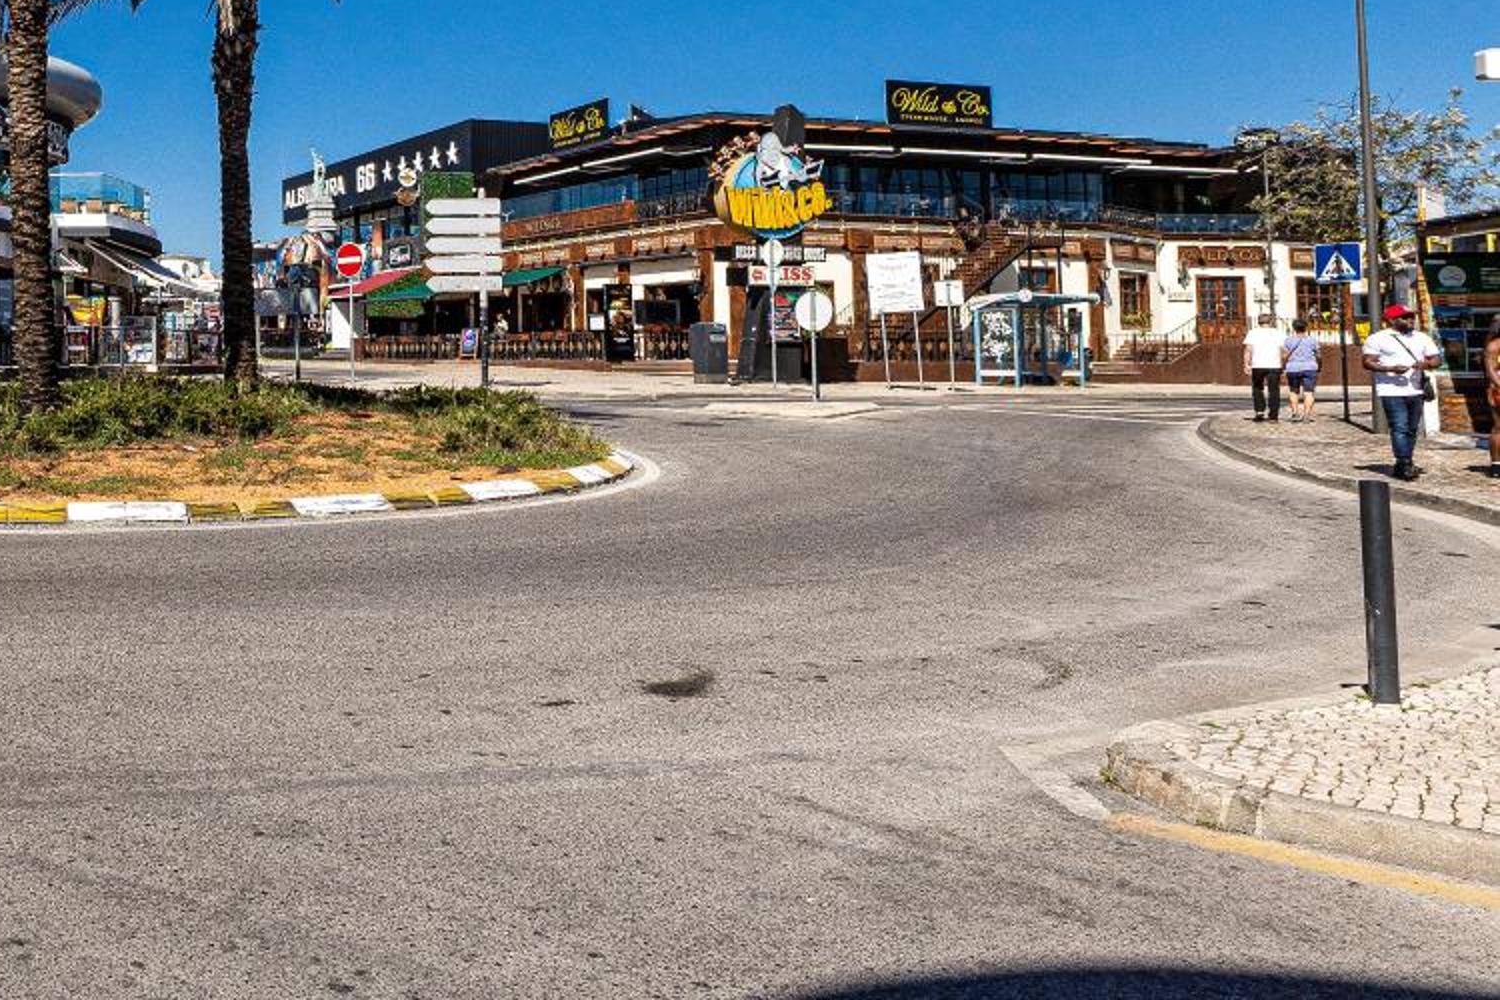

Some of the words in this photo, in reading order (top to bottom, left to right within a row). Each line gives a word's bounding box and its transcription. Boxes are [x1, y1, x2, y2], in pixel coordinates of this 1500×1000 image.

[892, 86, 939, 113] Wild
[356, 162, 376, 194] 66
[779, 266, 812, 281] ISS
